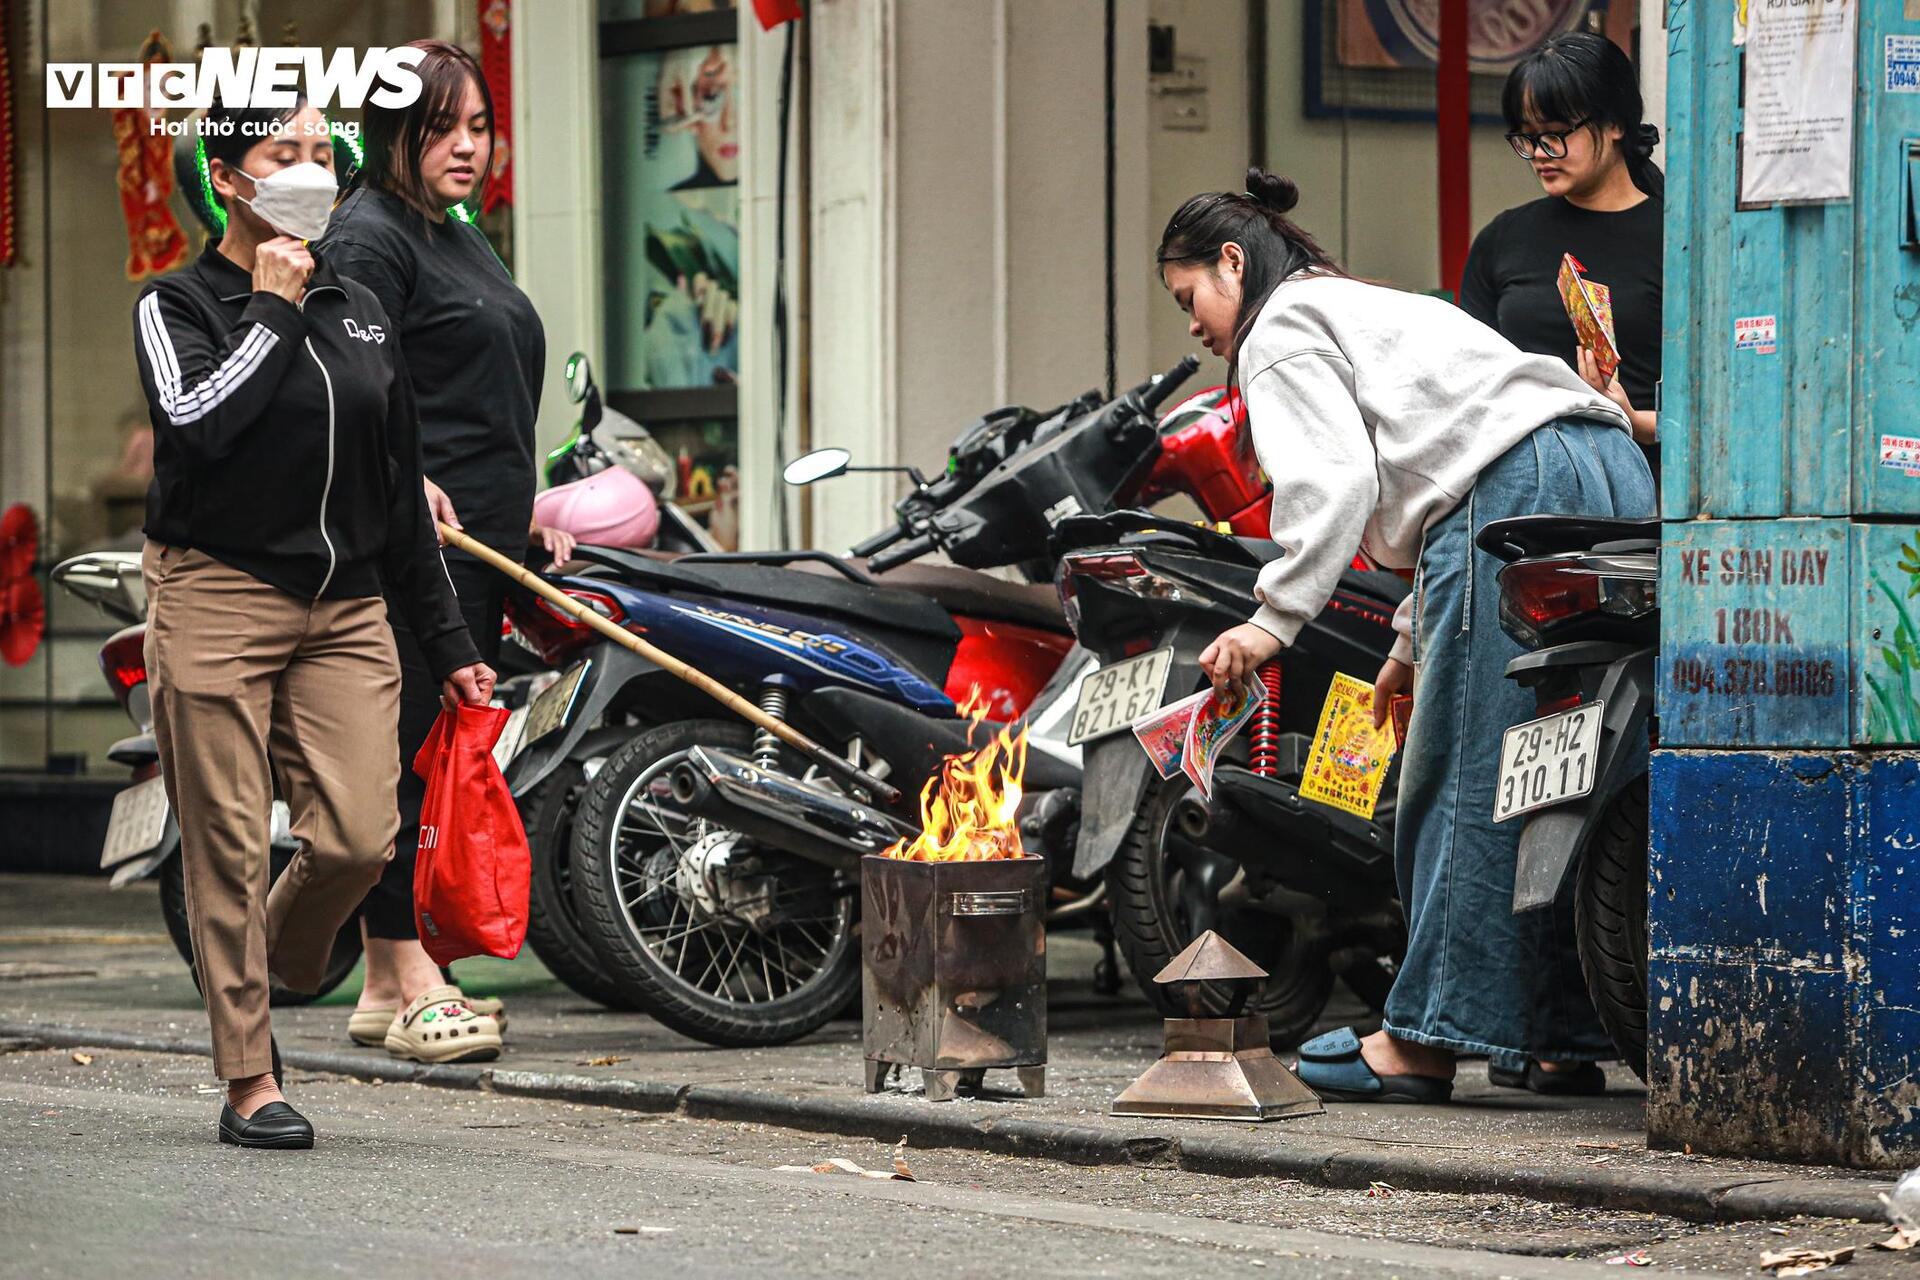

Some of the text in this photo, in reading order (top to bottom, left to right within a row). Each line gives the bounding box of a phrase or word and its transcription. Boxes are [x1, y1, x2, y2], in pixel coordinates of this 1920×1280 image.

[342, 318, 386, 345] D&G
[1681, 549, 1829, 586] XE SAN BAY
[1714, 607, 1794, 645] 180K
[1089, 656, 1156, 704] 29-K1
[1074, 687, 1156, 739] 821.62
[1513, 712, 1586, 768] 29-H2
[1501, 752, 1587, 813] 310.11
